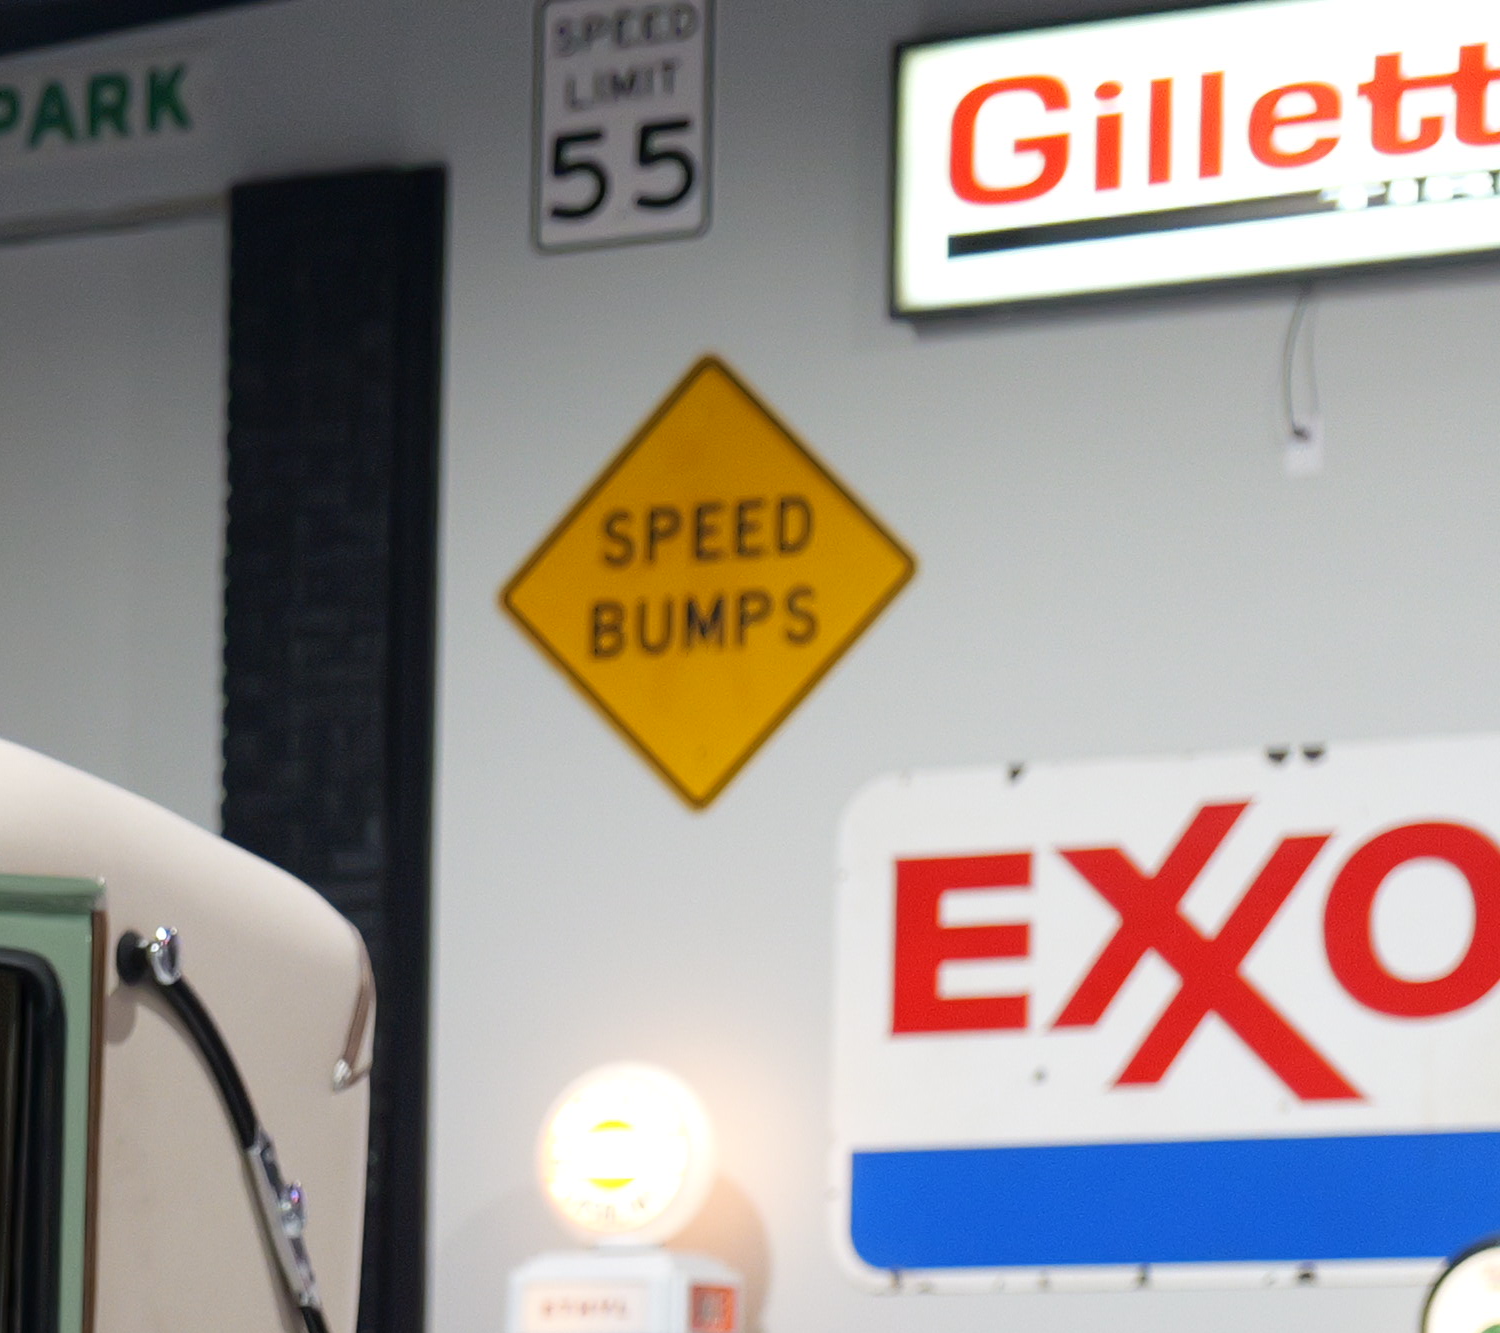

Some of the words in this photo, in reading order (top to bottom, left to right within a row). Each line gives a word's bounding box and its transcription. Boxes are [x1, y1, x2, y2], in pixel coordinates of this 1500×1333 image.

[554, 3, 700, 56] SPEED
[563, 58, 678, 113] LIMIT
[549, 116, 696, 220] 55
[603, 495, 813, 567] SPEED
[591, 586, 821, 659] BUMPS
[890, 797, 1500, 1104] EXXO
